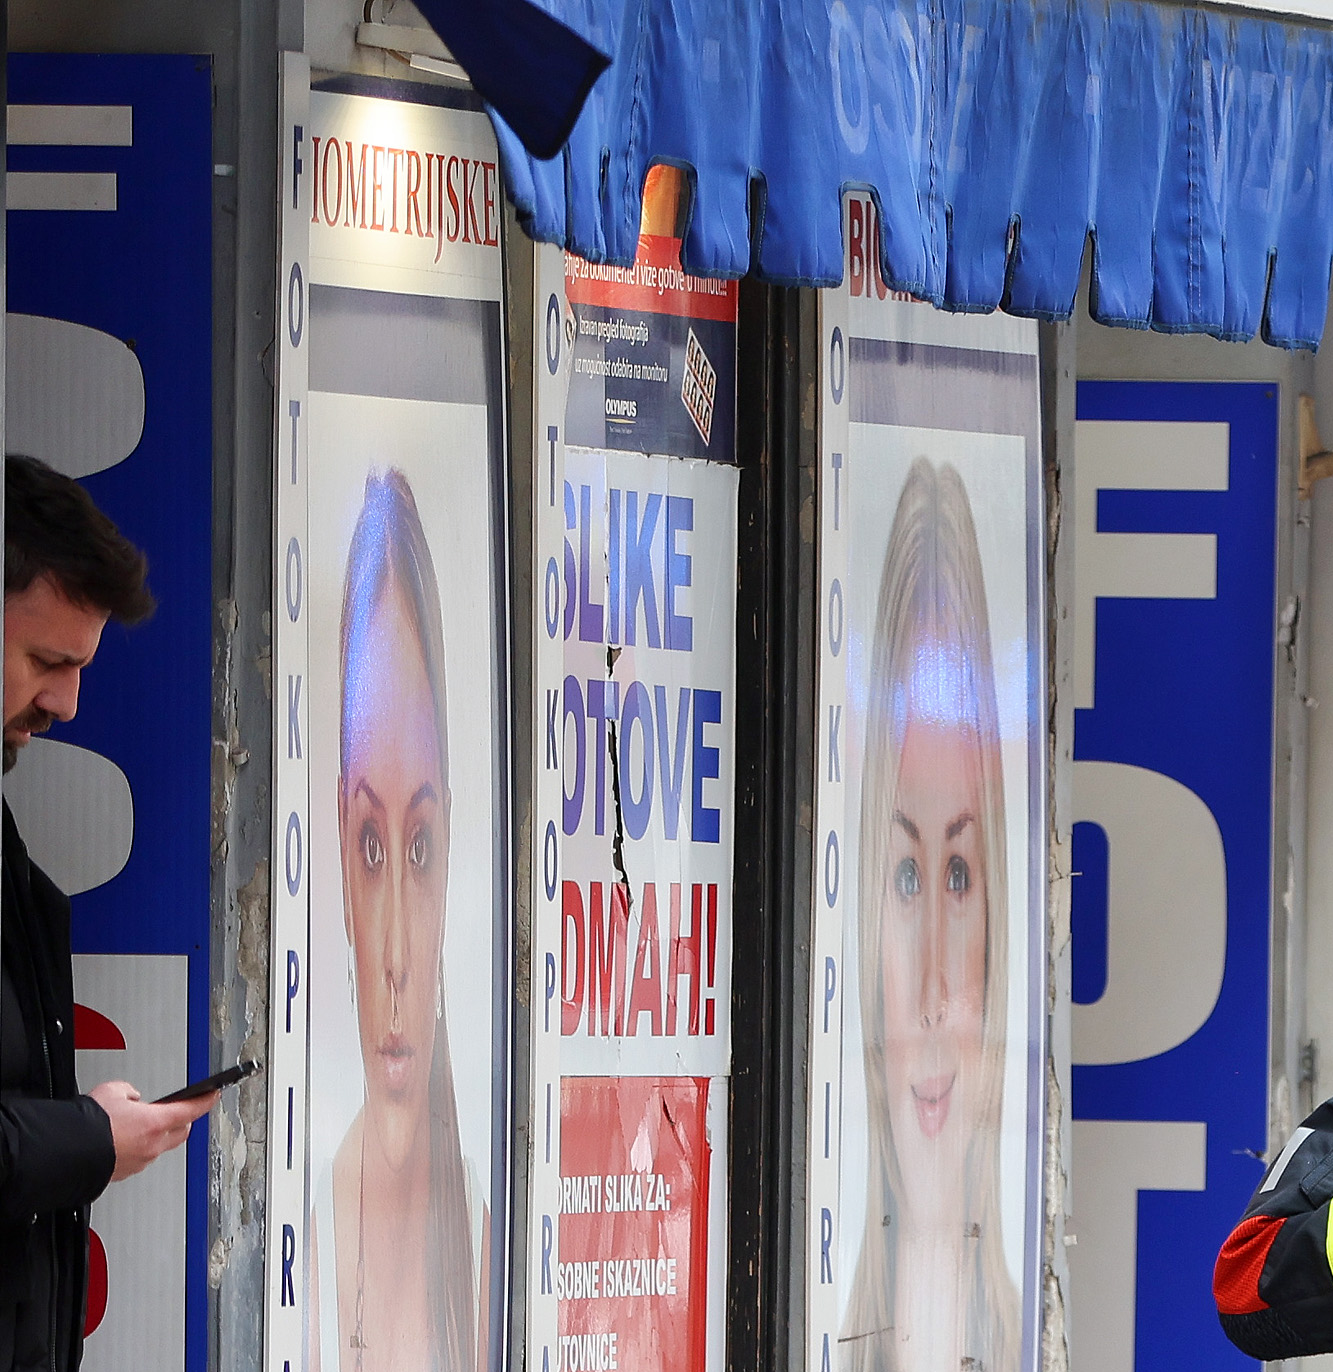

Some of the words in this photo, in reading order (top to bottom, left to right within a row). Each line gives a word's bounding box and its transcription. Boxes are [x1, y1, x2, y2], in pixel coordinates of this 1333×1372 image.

[640, 258, 658, 288] vize
[597, 317, 620, 343] pregled
[619, 318, 649, 346] fotografija
[610, 357, 633, 379] odabira
[633, 363, 641, 380] na
[641, 361, 668, 382] monitoru
[605, 398, 637, 417] OLYMPUS
[605, 1174, 643, 1213] SLIKA
[645, 1173, 671, 1211] ZA:
[603, 1258, 677, 1298] ISKAZNICE
